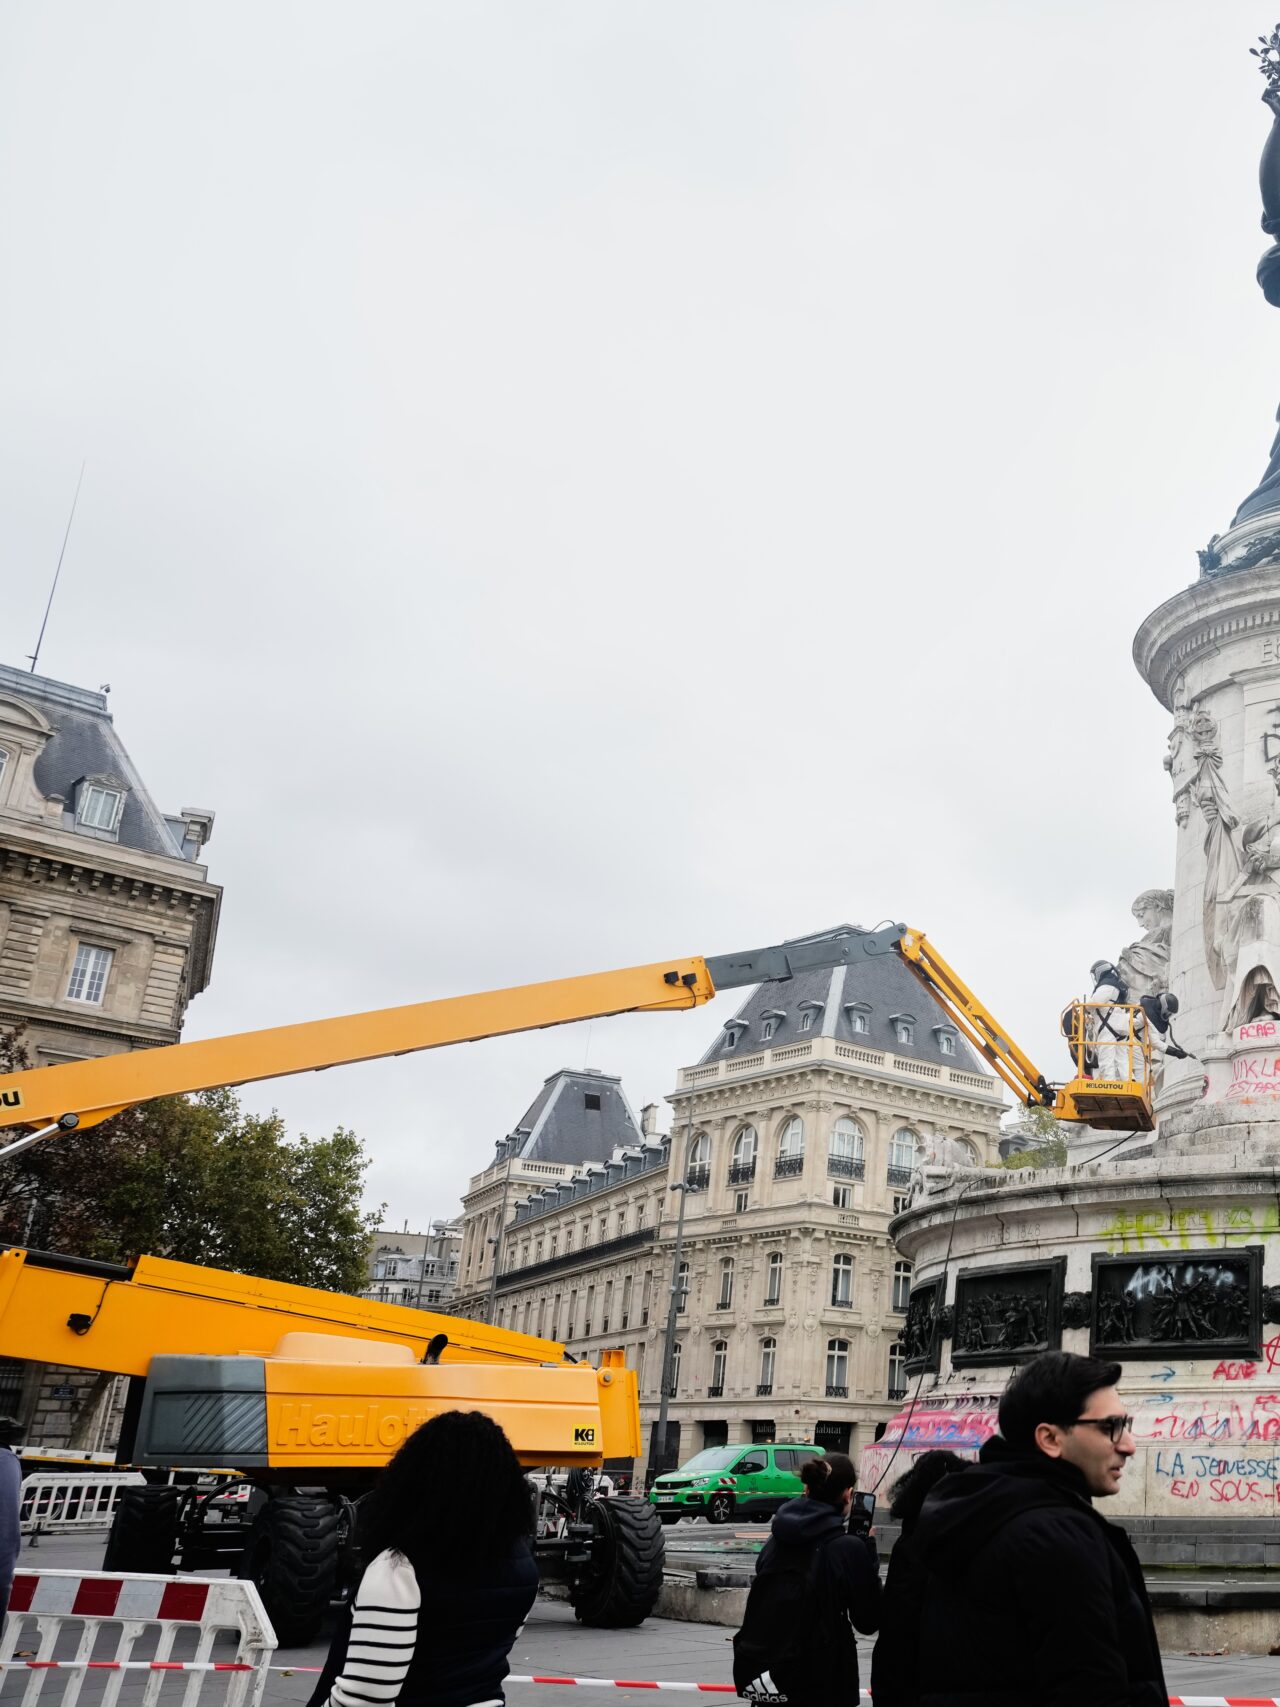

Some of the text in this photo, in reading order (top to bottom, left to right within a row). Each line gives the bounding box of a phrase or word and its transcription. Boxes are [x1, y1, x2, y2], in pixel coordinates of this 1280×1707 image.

[1239, 1021, 1277, 1041] ACAB
[1156, 1452, 1185, 1477] LA
[1170, 1480, 1200, 1500] EN
[742, 1690, 789, 1703] adidas
